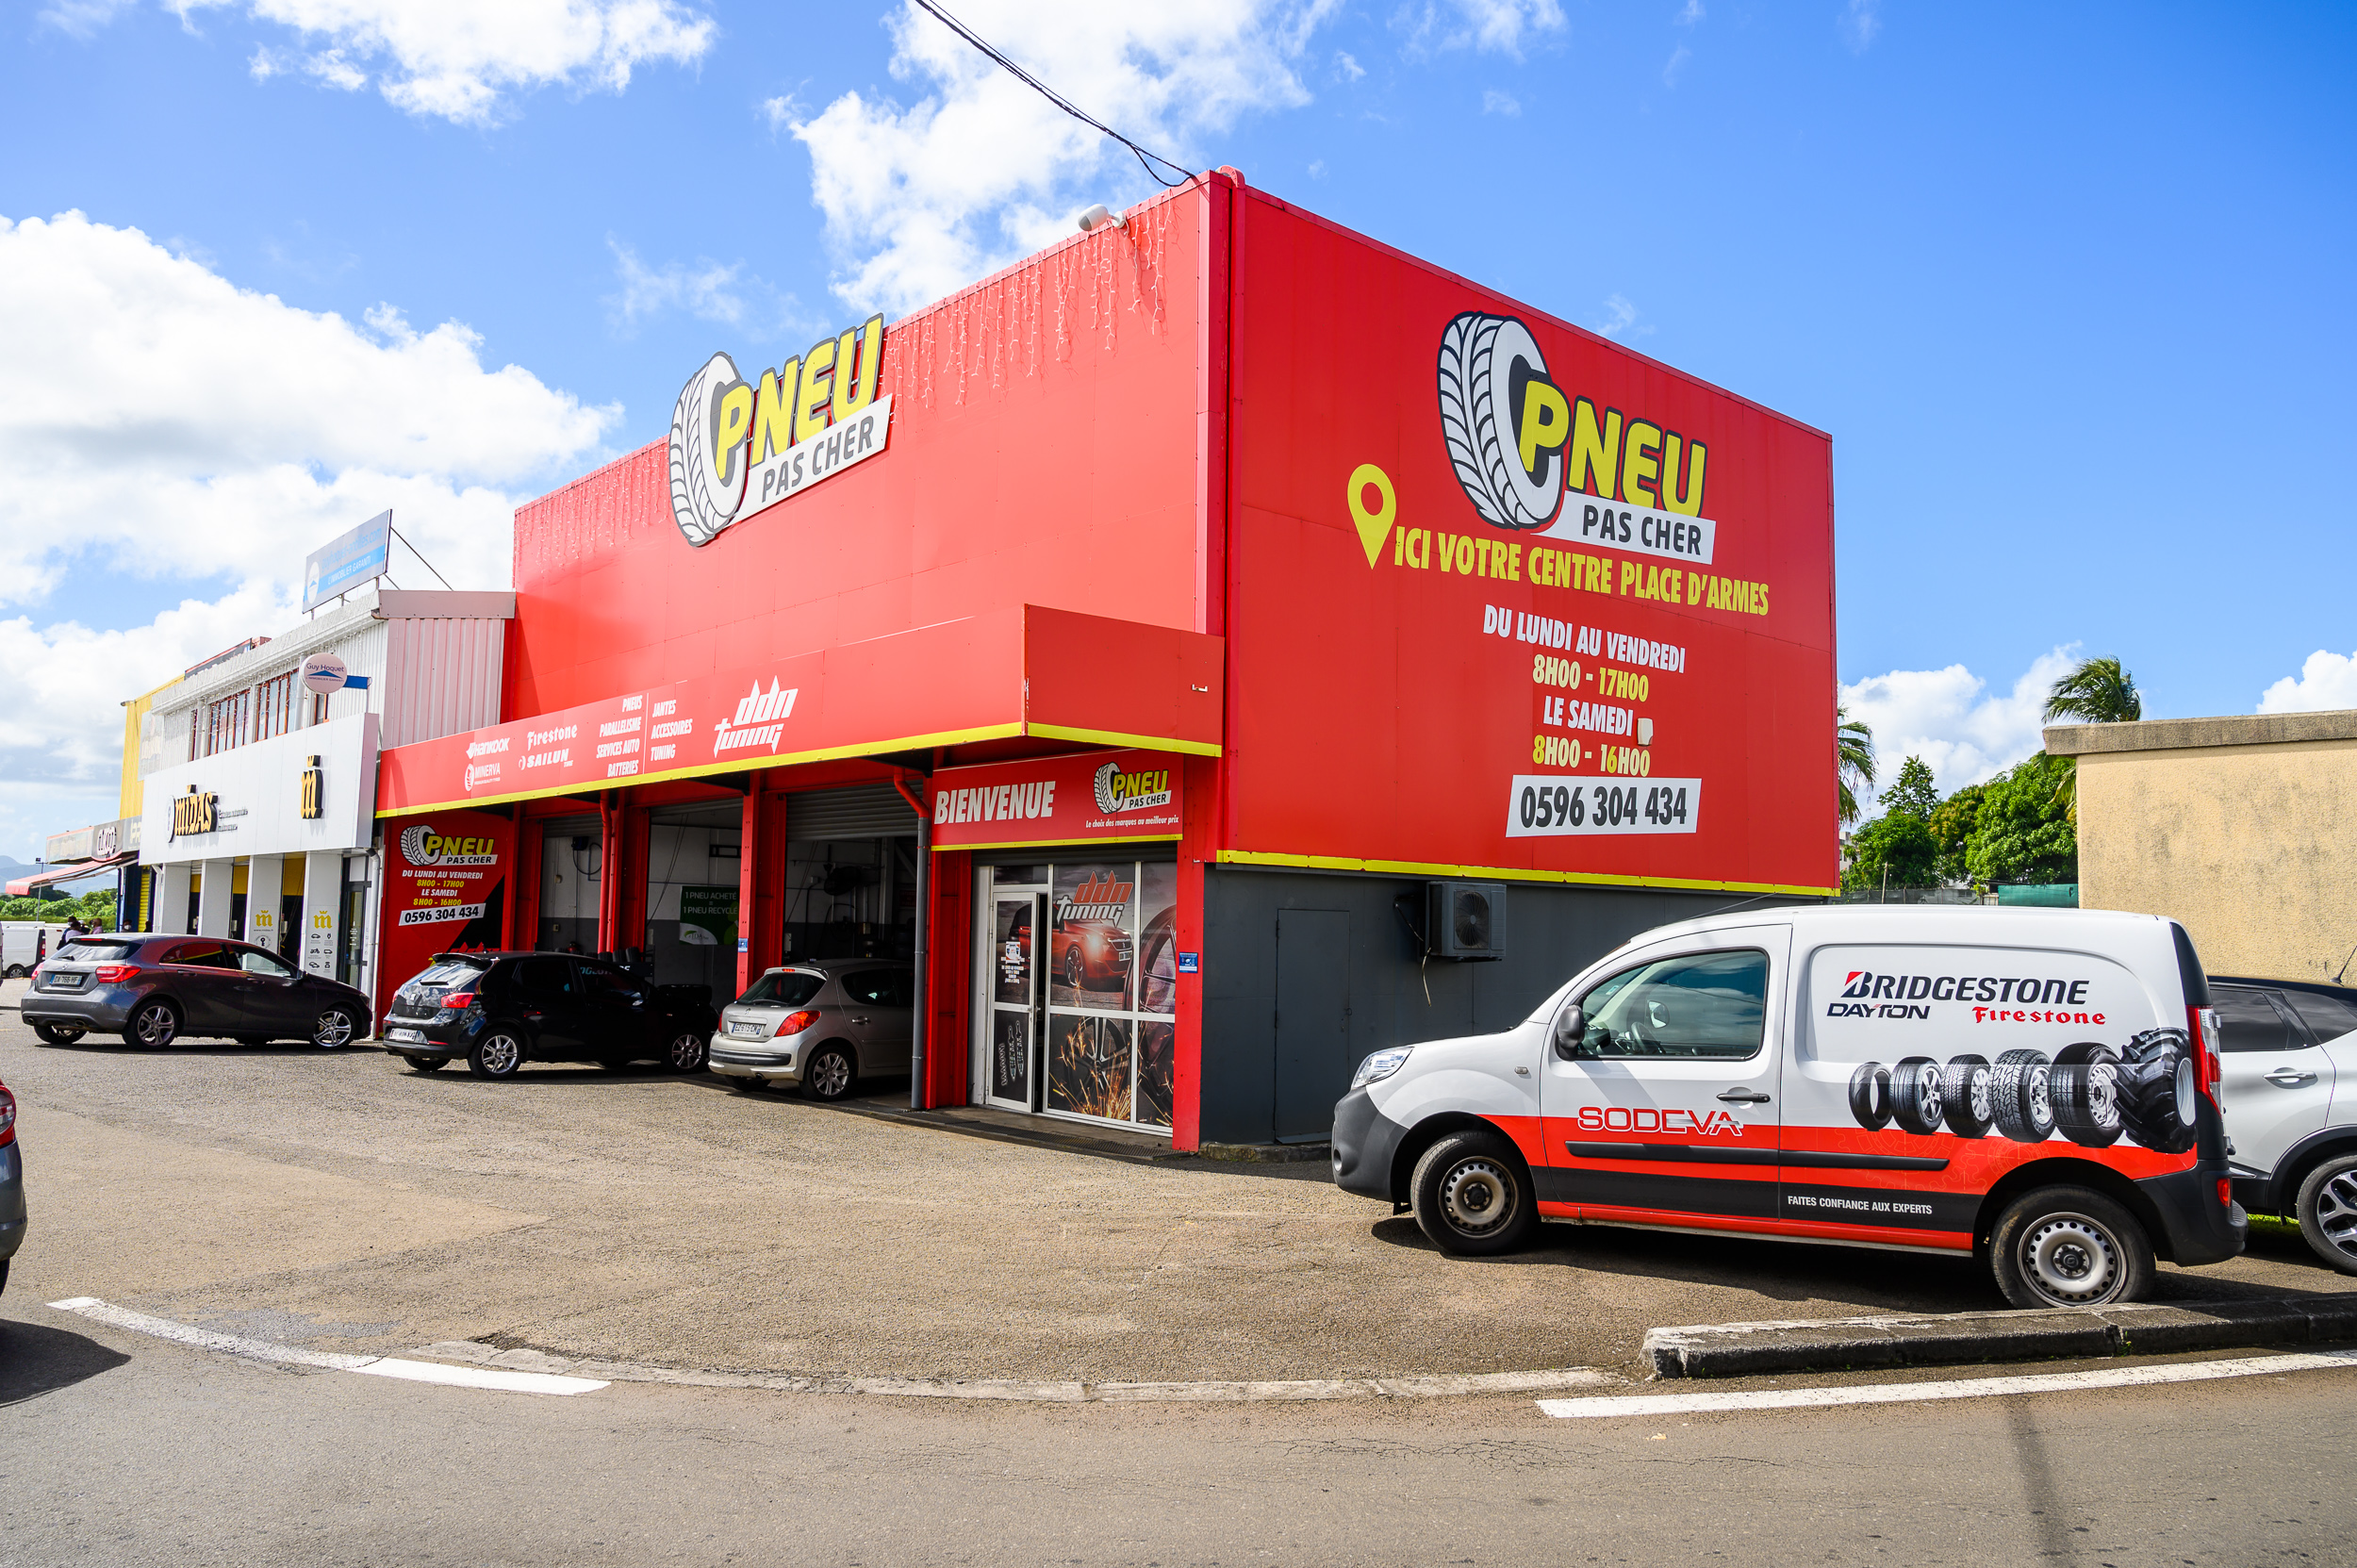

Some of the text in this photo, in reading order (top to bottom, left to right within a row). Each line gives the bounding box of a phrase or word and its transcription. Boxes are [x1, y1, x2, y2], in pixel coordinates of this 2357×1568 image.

[762, 415, 874, 503] PAS CHER
[1582, 504, 1702, 555] PAS CHER
[1394, 525, 1769, 616] ICI VOTRE CENTRE PLACE D'ARMES
[1482, 603, 1686, 674] DU LUNDI AU VENDREDI
[305, 662, 344, 672] Guy Hoquet
[1532, 653, 1649, 702] 8H00 - 17H00
[621, 695, 643, 713] PNEUS
[651, 700, 677, 718] JANTES
[1542, 695, 1634, 736] LE SAMEDI
[599, 717, 641, 737] PARALLELISME
[651, 718, 693, 739] ACCESSOIRES
[527, 724, 578, 751] Firestone
[596, 737, 640, 758] SERVICES AUTO
[651, 744, 676, 761] TUNING
[1532, 734, 1651, 778] 8H00 - 16H00
[526, 748, 569, 768] SAILUN
[475, 762, 501, 779] MINERVA
[607, 759, 639, 778] BATTERIES
[933, 781, 1056, 825] BIENVENUE
[1129, 793, 1166, 808] PAS CHER
[1520, 785, 1687, 829] 0596 304 434
[1105, 818, 1114, 827] des
[1114, 818, 1137, 827] marques
[1145, 816, 1167, 825] meilleur
[1167, 815, 1179, 825] prix
[416, 879, 436, 887] 8H00
[442, 880, 465, 888] 17H00
[449, 871, 484, 880] VENDREDI
[413, 898, 433, 906] 8H00
[420, 888, 430, 897] LE
[689, 891, 709, 900] PNEU
[710, 890, 737, 900] ACHETÉ
[404, 906, 479, 923] 0596 304 434
[688, 906, 707, 915] PNEU
[1839, 971, 2090, 1005] BRIDGESTONE
[1826, 1002, 1931, 1019] DAYTON
[1972, 1006, 2106, 1025] Firestone
[1577, 1106, 1743, 1137] SODEVA
[1788, 1196, 1933, 1215] FAITES CONFIANCE AUX EXPERTS
